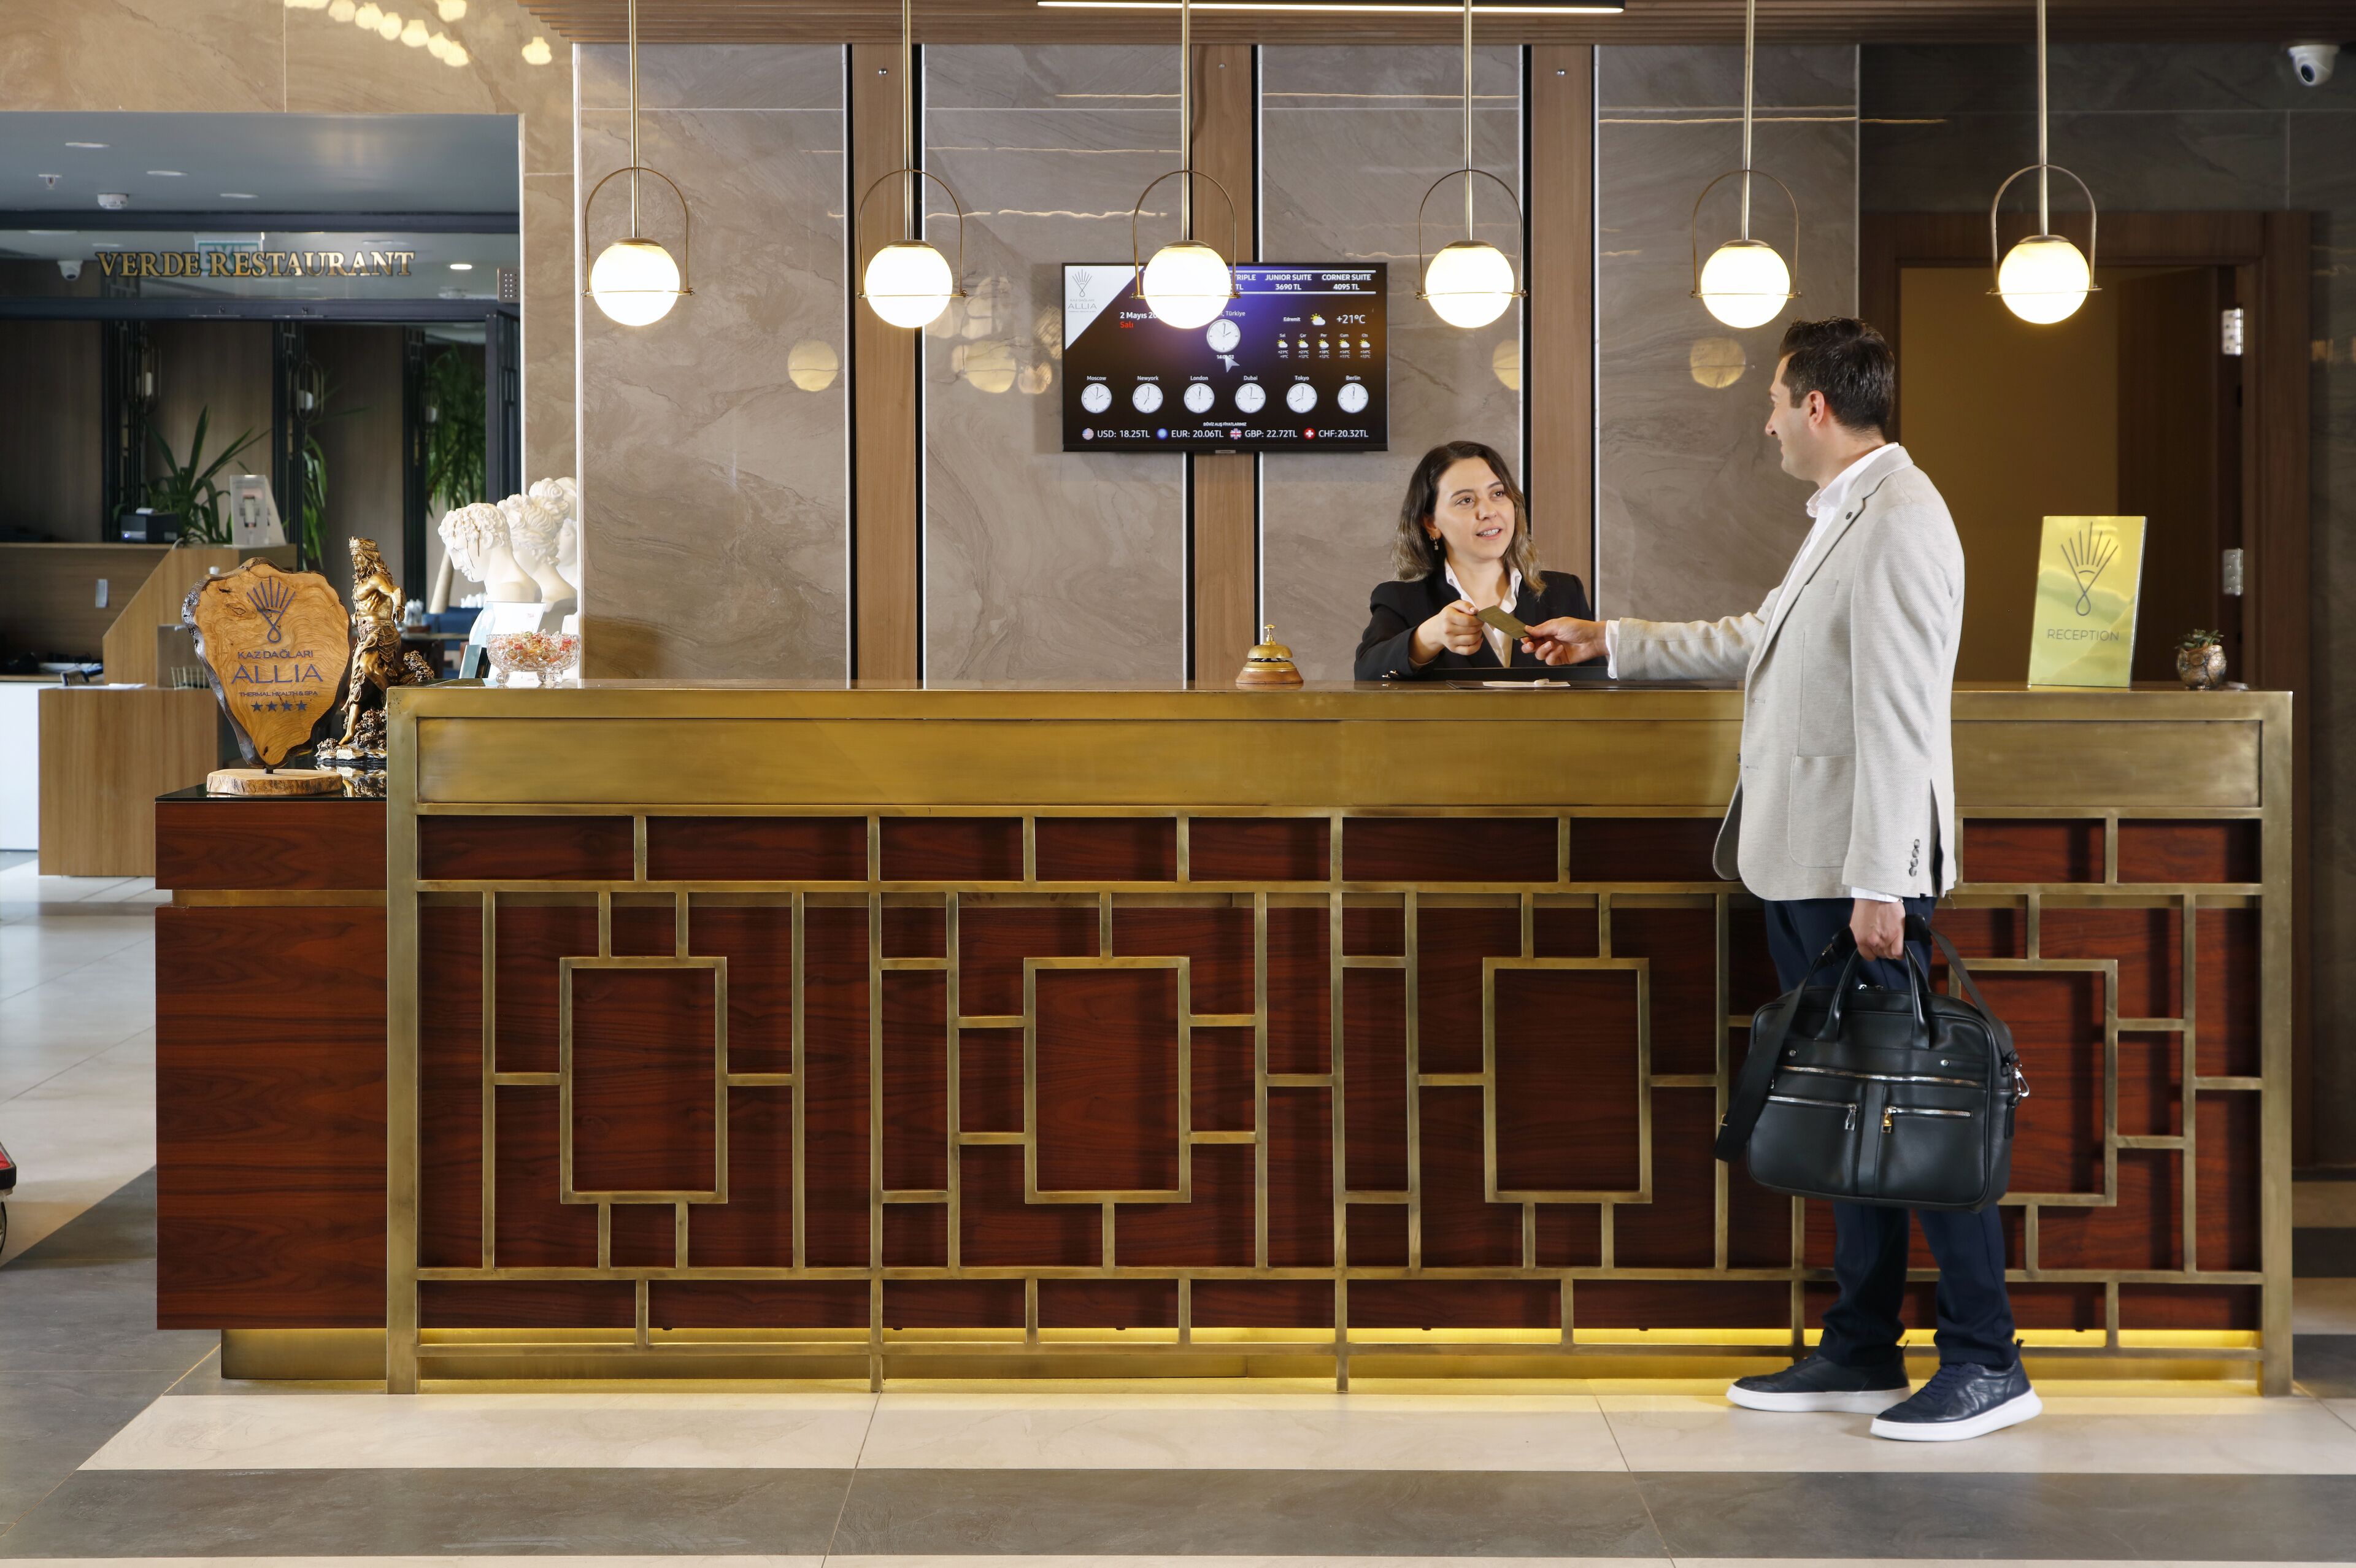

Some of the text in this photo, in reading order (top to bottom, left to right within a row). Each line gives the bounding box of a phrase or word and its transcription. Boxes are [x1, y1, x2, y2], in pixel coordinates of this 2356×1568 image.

[96, 251, 415, 277] VERDE RESTAURANT
[199, 245, 258, 269] EXT
[1126, 312, 1147, 320] Mayıs
[2047, 628, 2119, 641] RECEPTION
[263, 648, 314, 659] DAĞLARI
[231, 663, 323, 684] ALLIA
